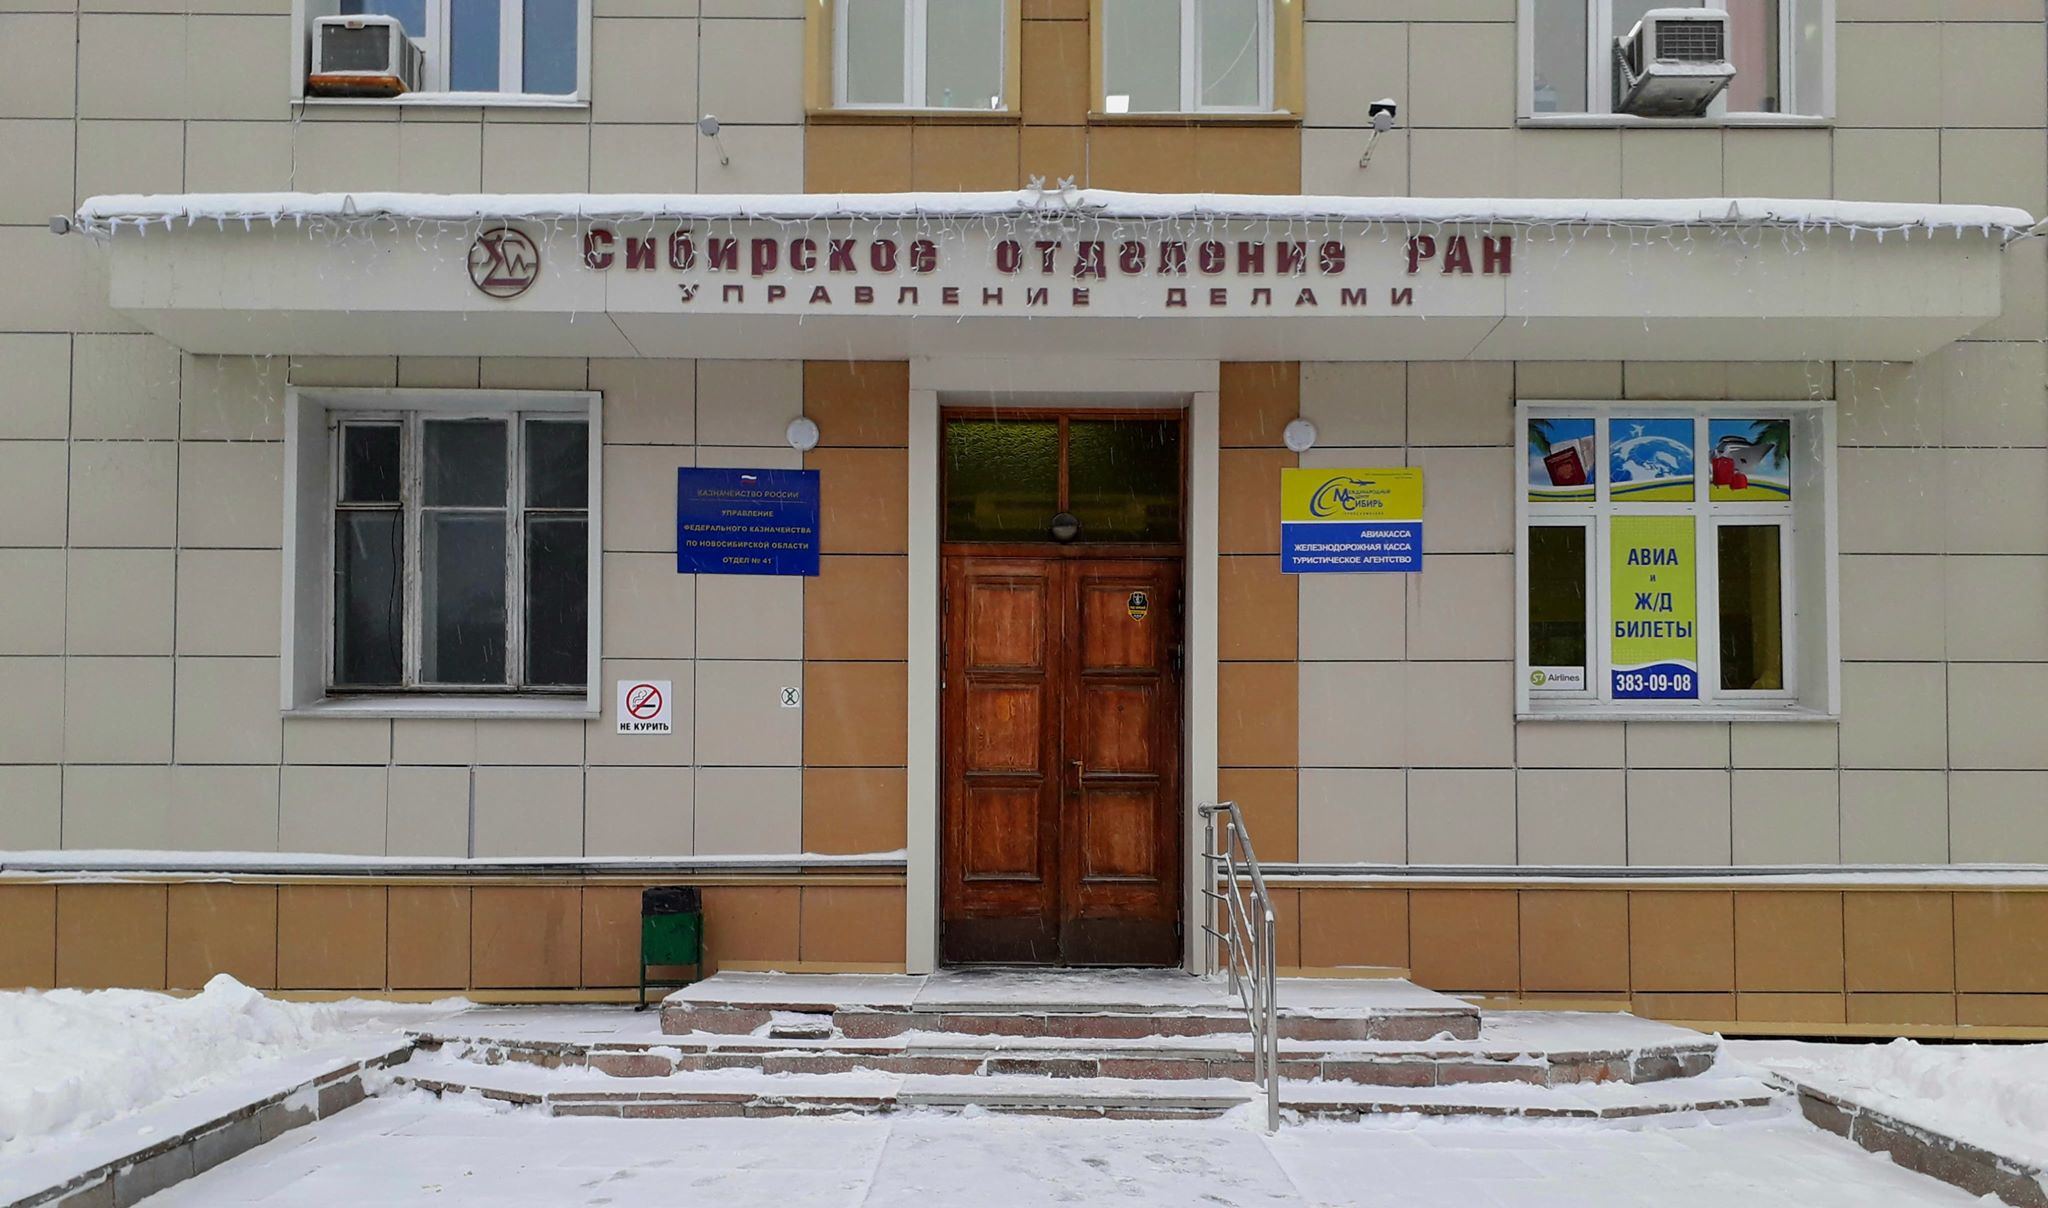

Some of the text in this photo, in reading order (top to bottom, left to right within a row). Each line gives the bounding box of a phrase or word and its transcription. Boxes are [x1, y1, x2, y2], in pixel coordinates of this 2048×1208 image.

[1408, 235, 1512, 275] РАН
[679, 284, 1415, 308] УПРАВЛЕНИЕ ДЕЛАМИ
[764, 490, 799, 499] РОССИИ
[721, 509, 774, 518] УПРАВЛЕНИЕ
[683, 524, 812, 535] ФЕДЕРАЛЬНОГО КАЗНАЧЕЙСТВА
[1360, 530, 1412, 538] АВИАКАССА
[686, 540, 809, 550] ПО НОВОСИБИРСКОЙ ОБЛАСТИ
[1294, 543, 1412, 552] ЖЕЛЕЗНОДОРОЖНАЯ КАССА
[722, 556, 772, 566] ОТДЕЛ № 41
[1292, 556, 1412, 565] ТУРИСТИЧЕСКОЕ АГЕНТСТВО
[1627, 548, 1679, 566] АВИА
[1634, 592, 1673, 612] Ж/Д
[1615, 621, 1693, 639] БИЛЕТЫ
[1548, 673, 1580, 682] Airlines
[1616, 674, 1691, 692] 383-09-08
[620, 722, 669, 731] НЕ КУРИТЬ
